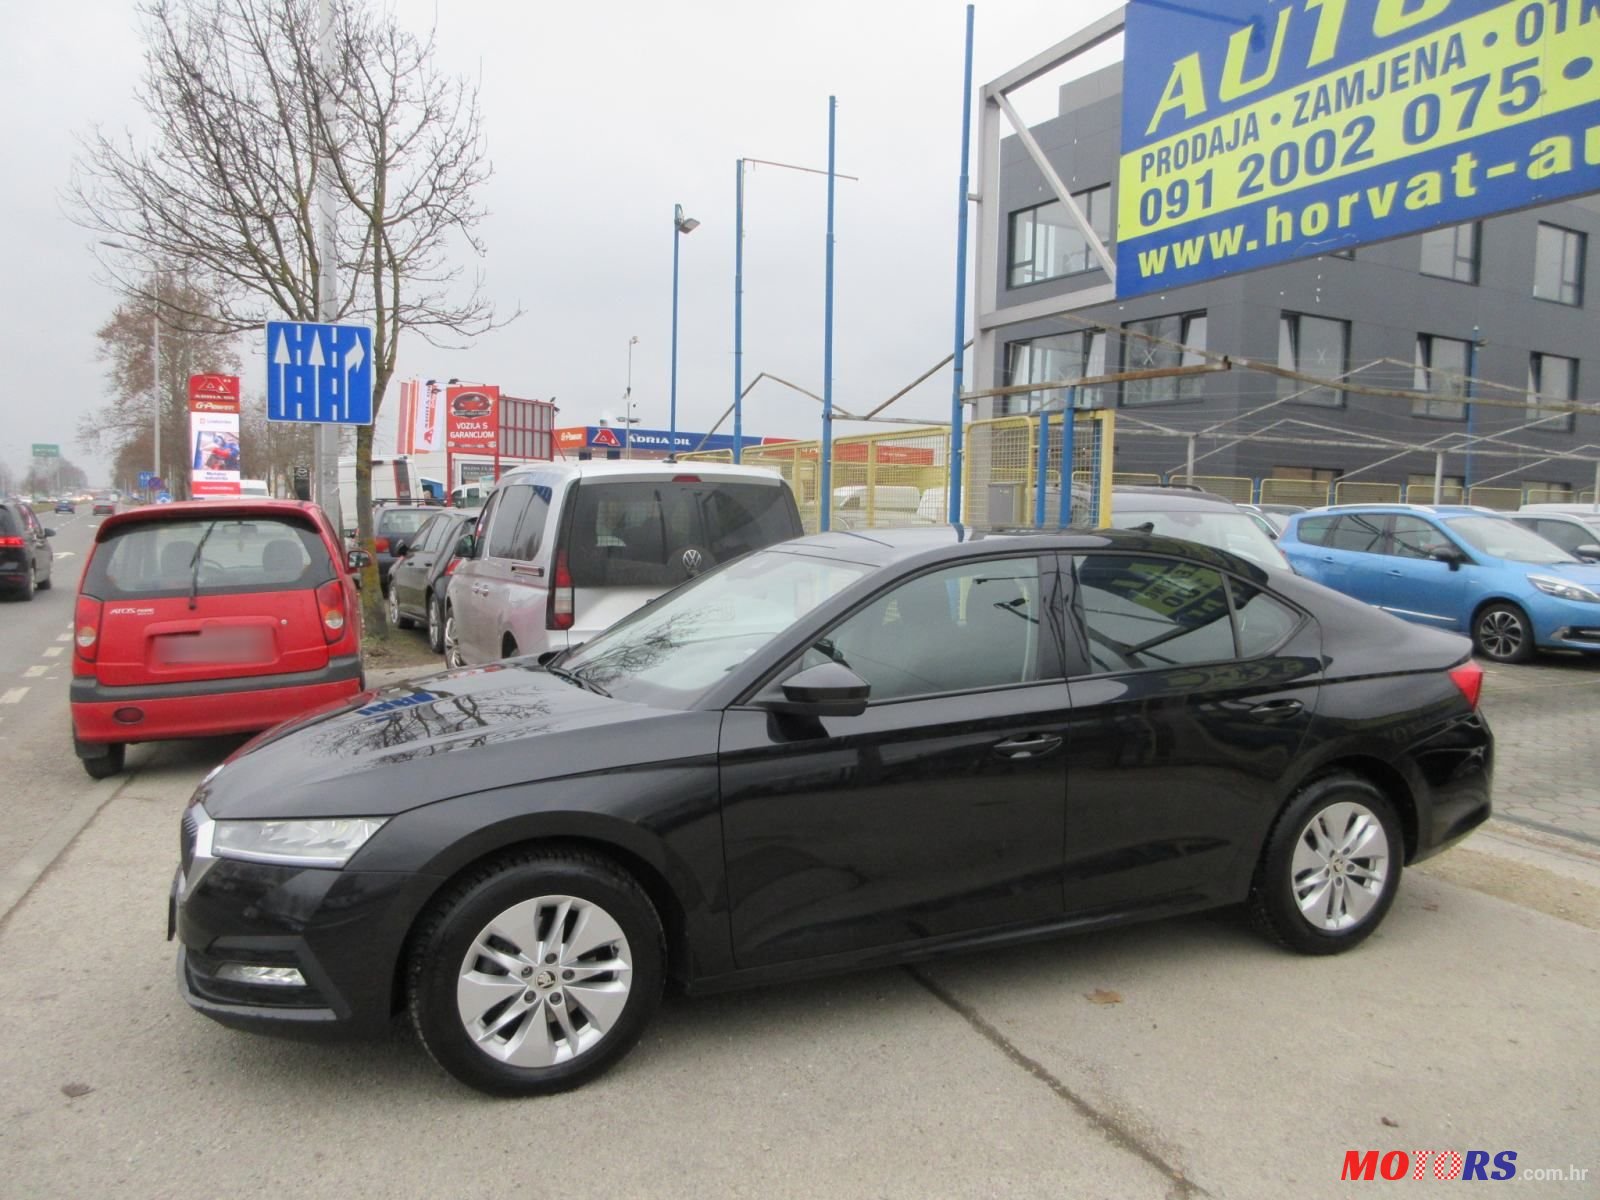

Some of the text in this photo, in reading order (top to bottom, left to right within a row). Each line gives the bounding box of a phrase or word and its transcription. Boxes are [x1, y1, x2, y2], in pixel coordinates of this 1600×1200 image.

[1141, 112, 1259, 182] PRODAJA
[1292, 32, 1466, 128] ZAMJENA
[1140, 57, 1541, 227] 091 2002 075
[456, 422, 488, 430] VOZILA S
[450, 431, 494, 439] GARANCIJOM
[628, 434, 670, 444] ADRIA
